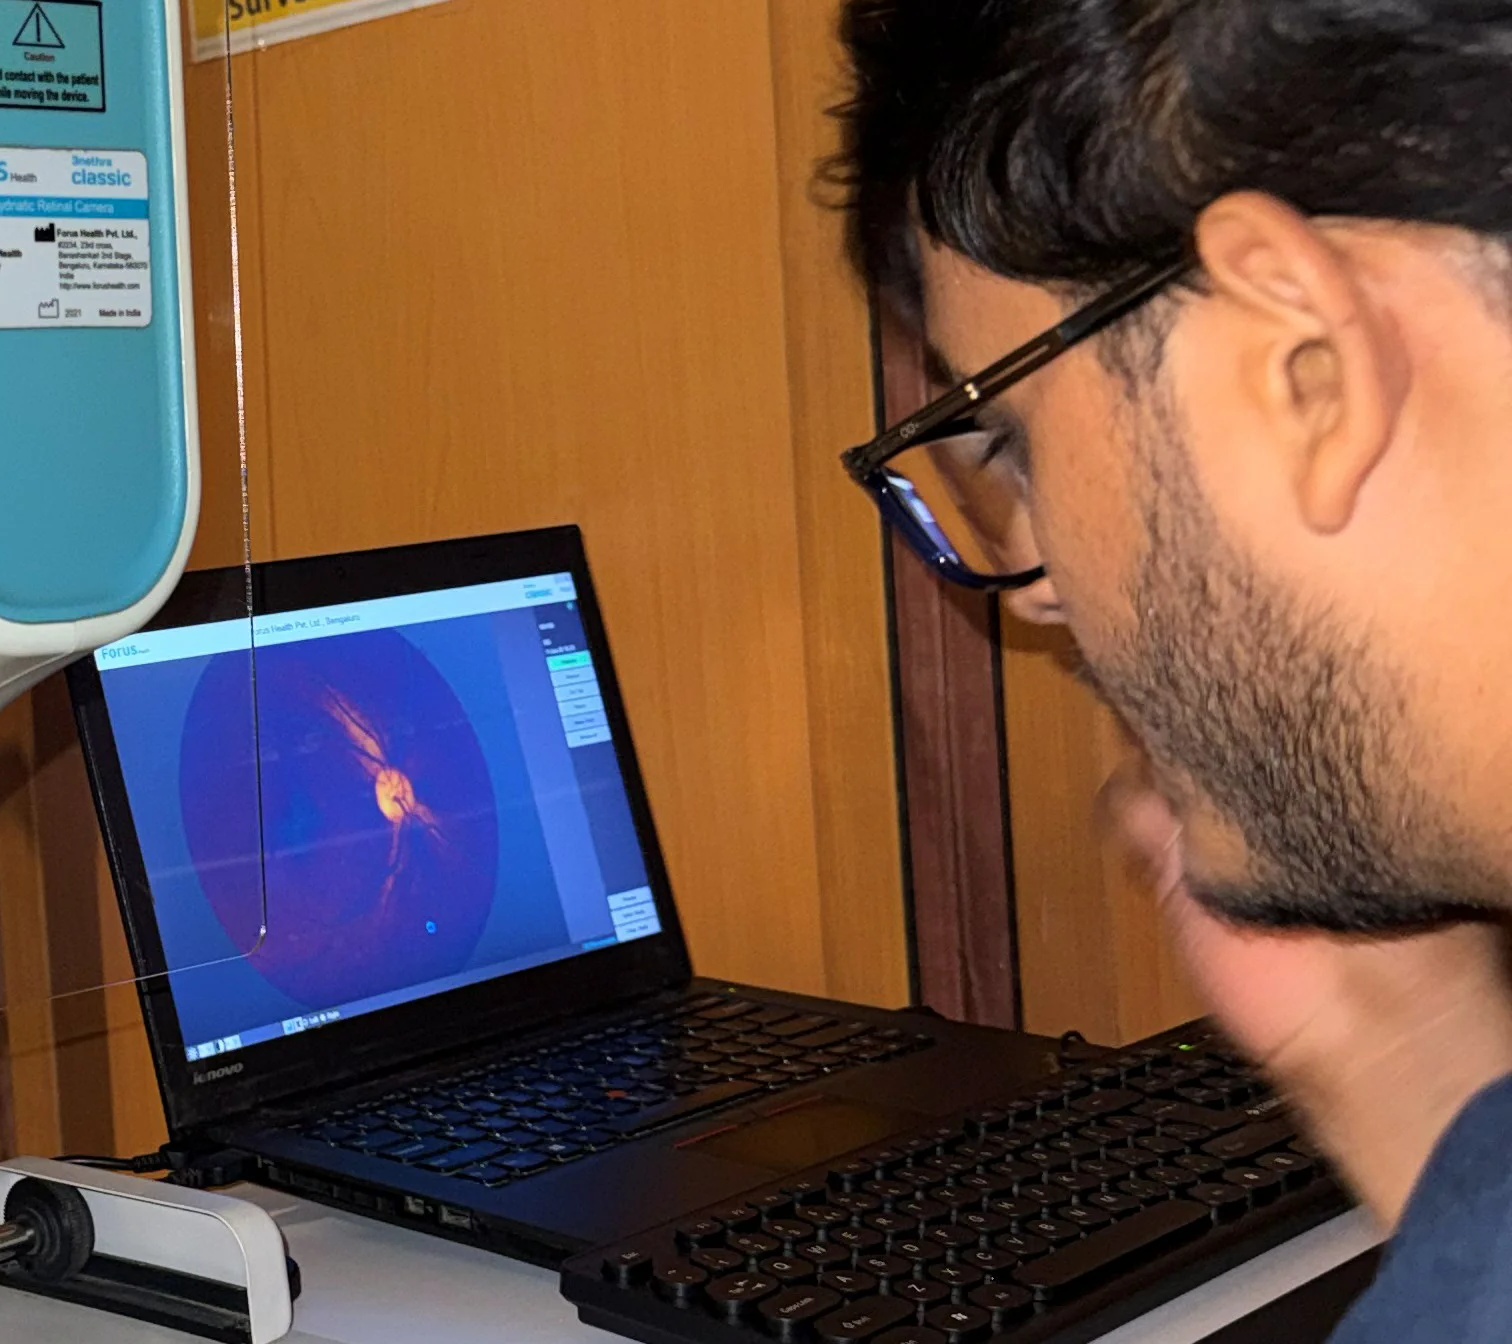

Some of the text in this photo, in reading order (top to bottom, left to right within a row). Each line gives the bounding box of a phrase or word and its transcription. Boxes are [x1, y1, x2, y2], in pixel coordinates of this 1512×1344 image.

[24, 51, 55, 62] Caution
[5, 70, 35, 82] contact
[37, 71, 55, 83] with
[56, 72, 69, 84] the
[71, 73, 99, 87] patient
[13, 88, 44, 103] moving
[46, 89, 58, 101] the
[10, 172, 37, 183] Health
[71, 169, 132, 186] classic
[38, 199, 72, 213] Retinal
[74, 200, 114, 214] Camera
[57, 228, 78, 238] Forus
[80, 228, 104, 238] Health
[101, 645, 138, 660] Forus
